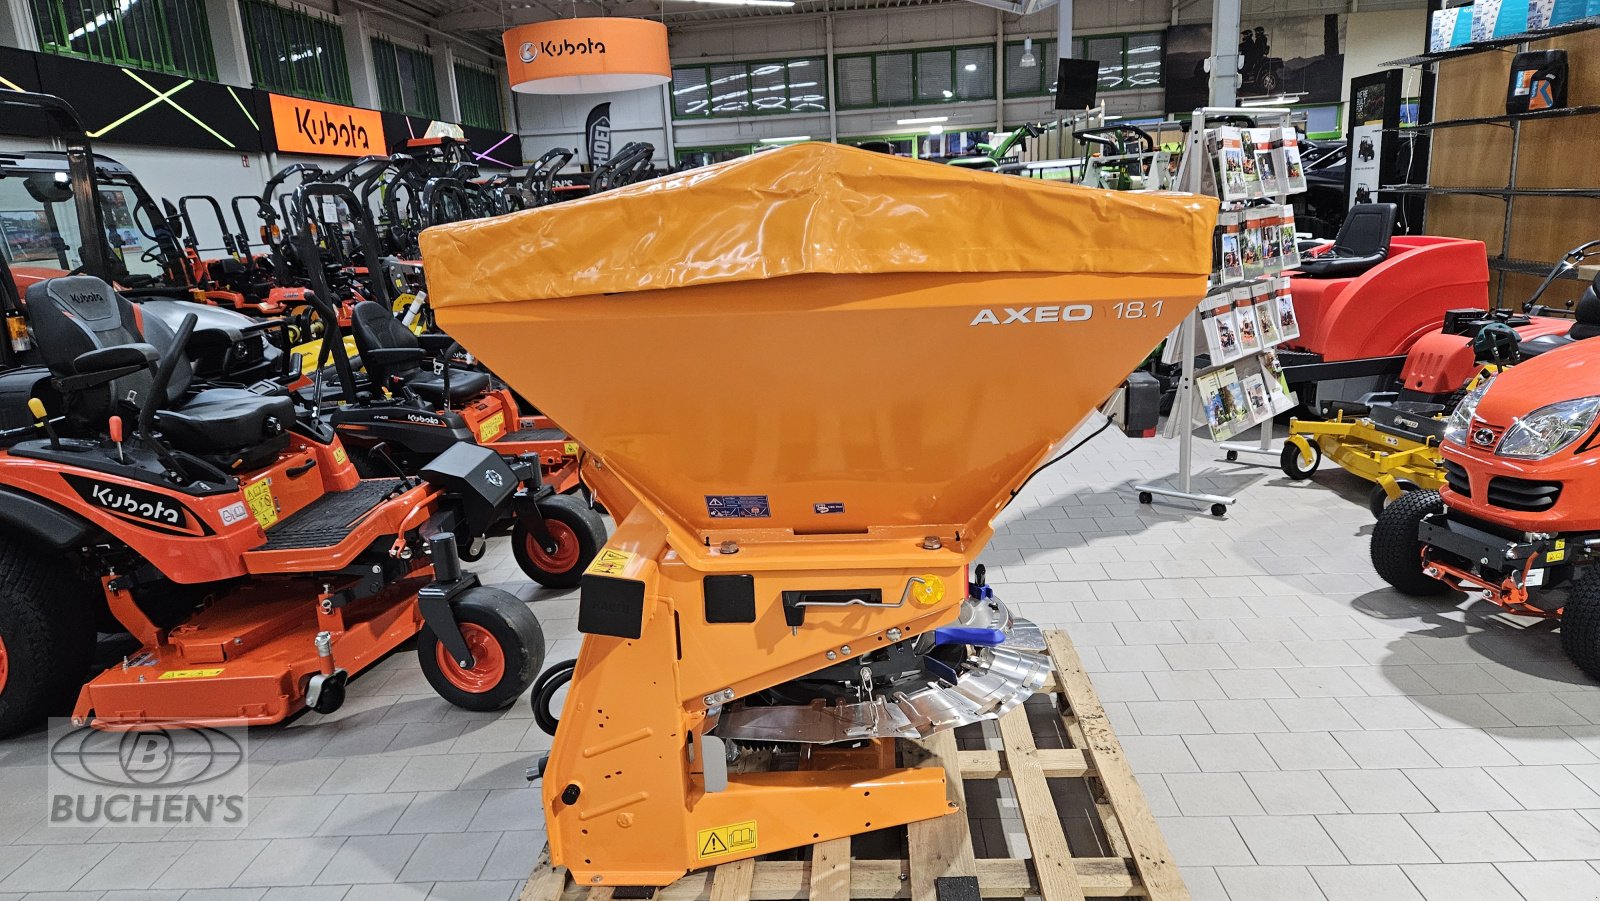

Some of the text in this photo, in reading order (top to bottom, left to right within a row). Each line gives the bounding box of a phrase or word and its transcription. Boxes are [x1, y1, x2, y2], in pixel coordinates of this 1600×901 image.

[541, 38, 606, 56] Kubota
[295, 107, 369, 149] Kubota
[593, 125, 611, 172] HOEI
[70, 292, 104, 303] Kubota
[970, 300, 1164, 326] AXEO 18.1
[407, 413, 439, 425] Kubota
[92, 484, 179, 523] Kubota
